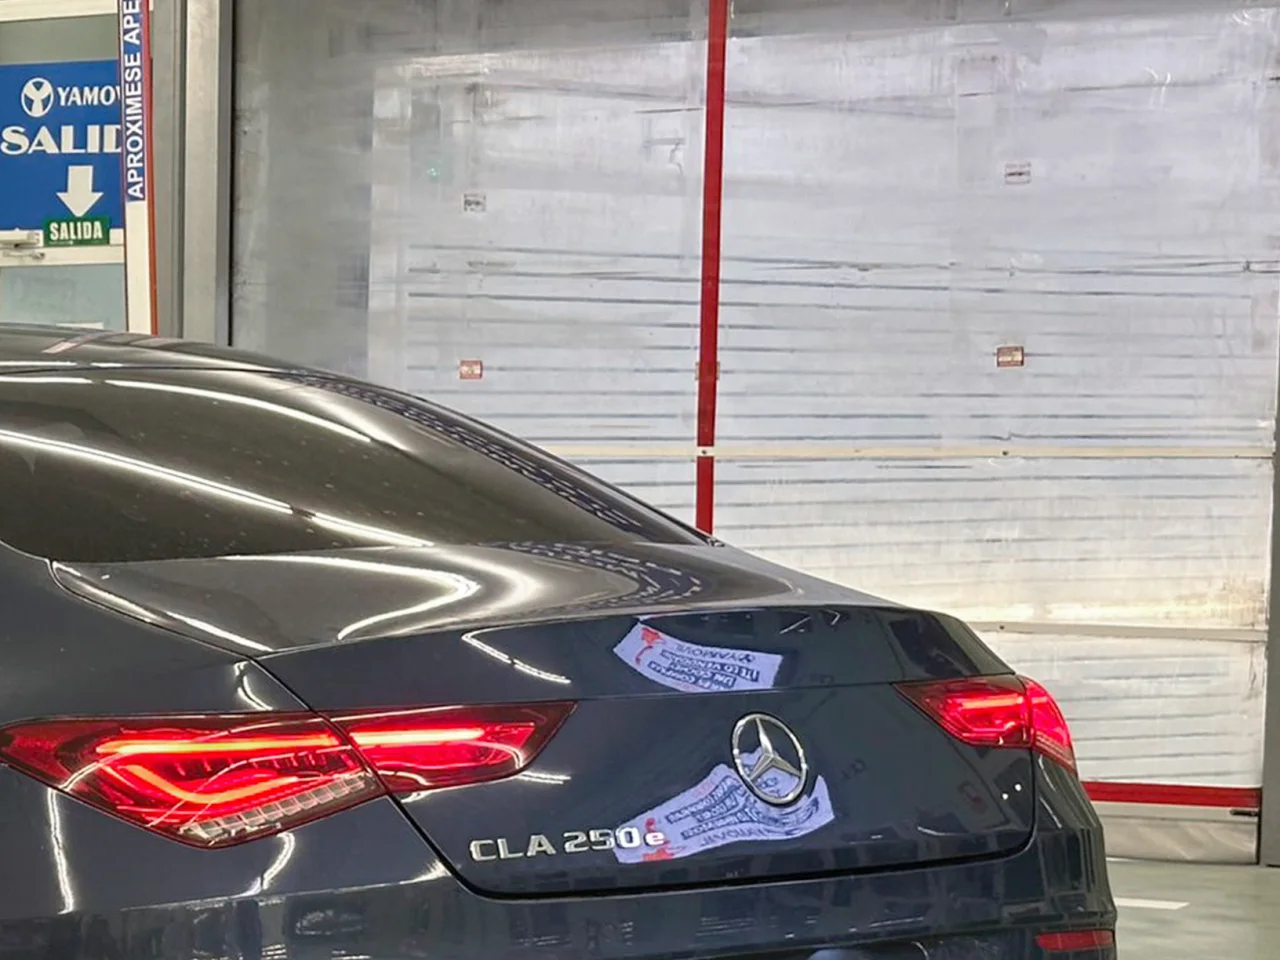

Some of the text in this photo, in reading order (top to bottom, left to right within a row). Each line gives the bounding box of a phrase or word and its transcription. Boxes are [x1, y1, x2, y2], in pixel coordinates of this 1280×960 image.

[123, 52, 144, 199] APROXIMESE
[49, 221, 103, 241] SALIDA
[470, 834, 556, 861] CLA
